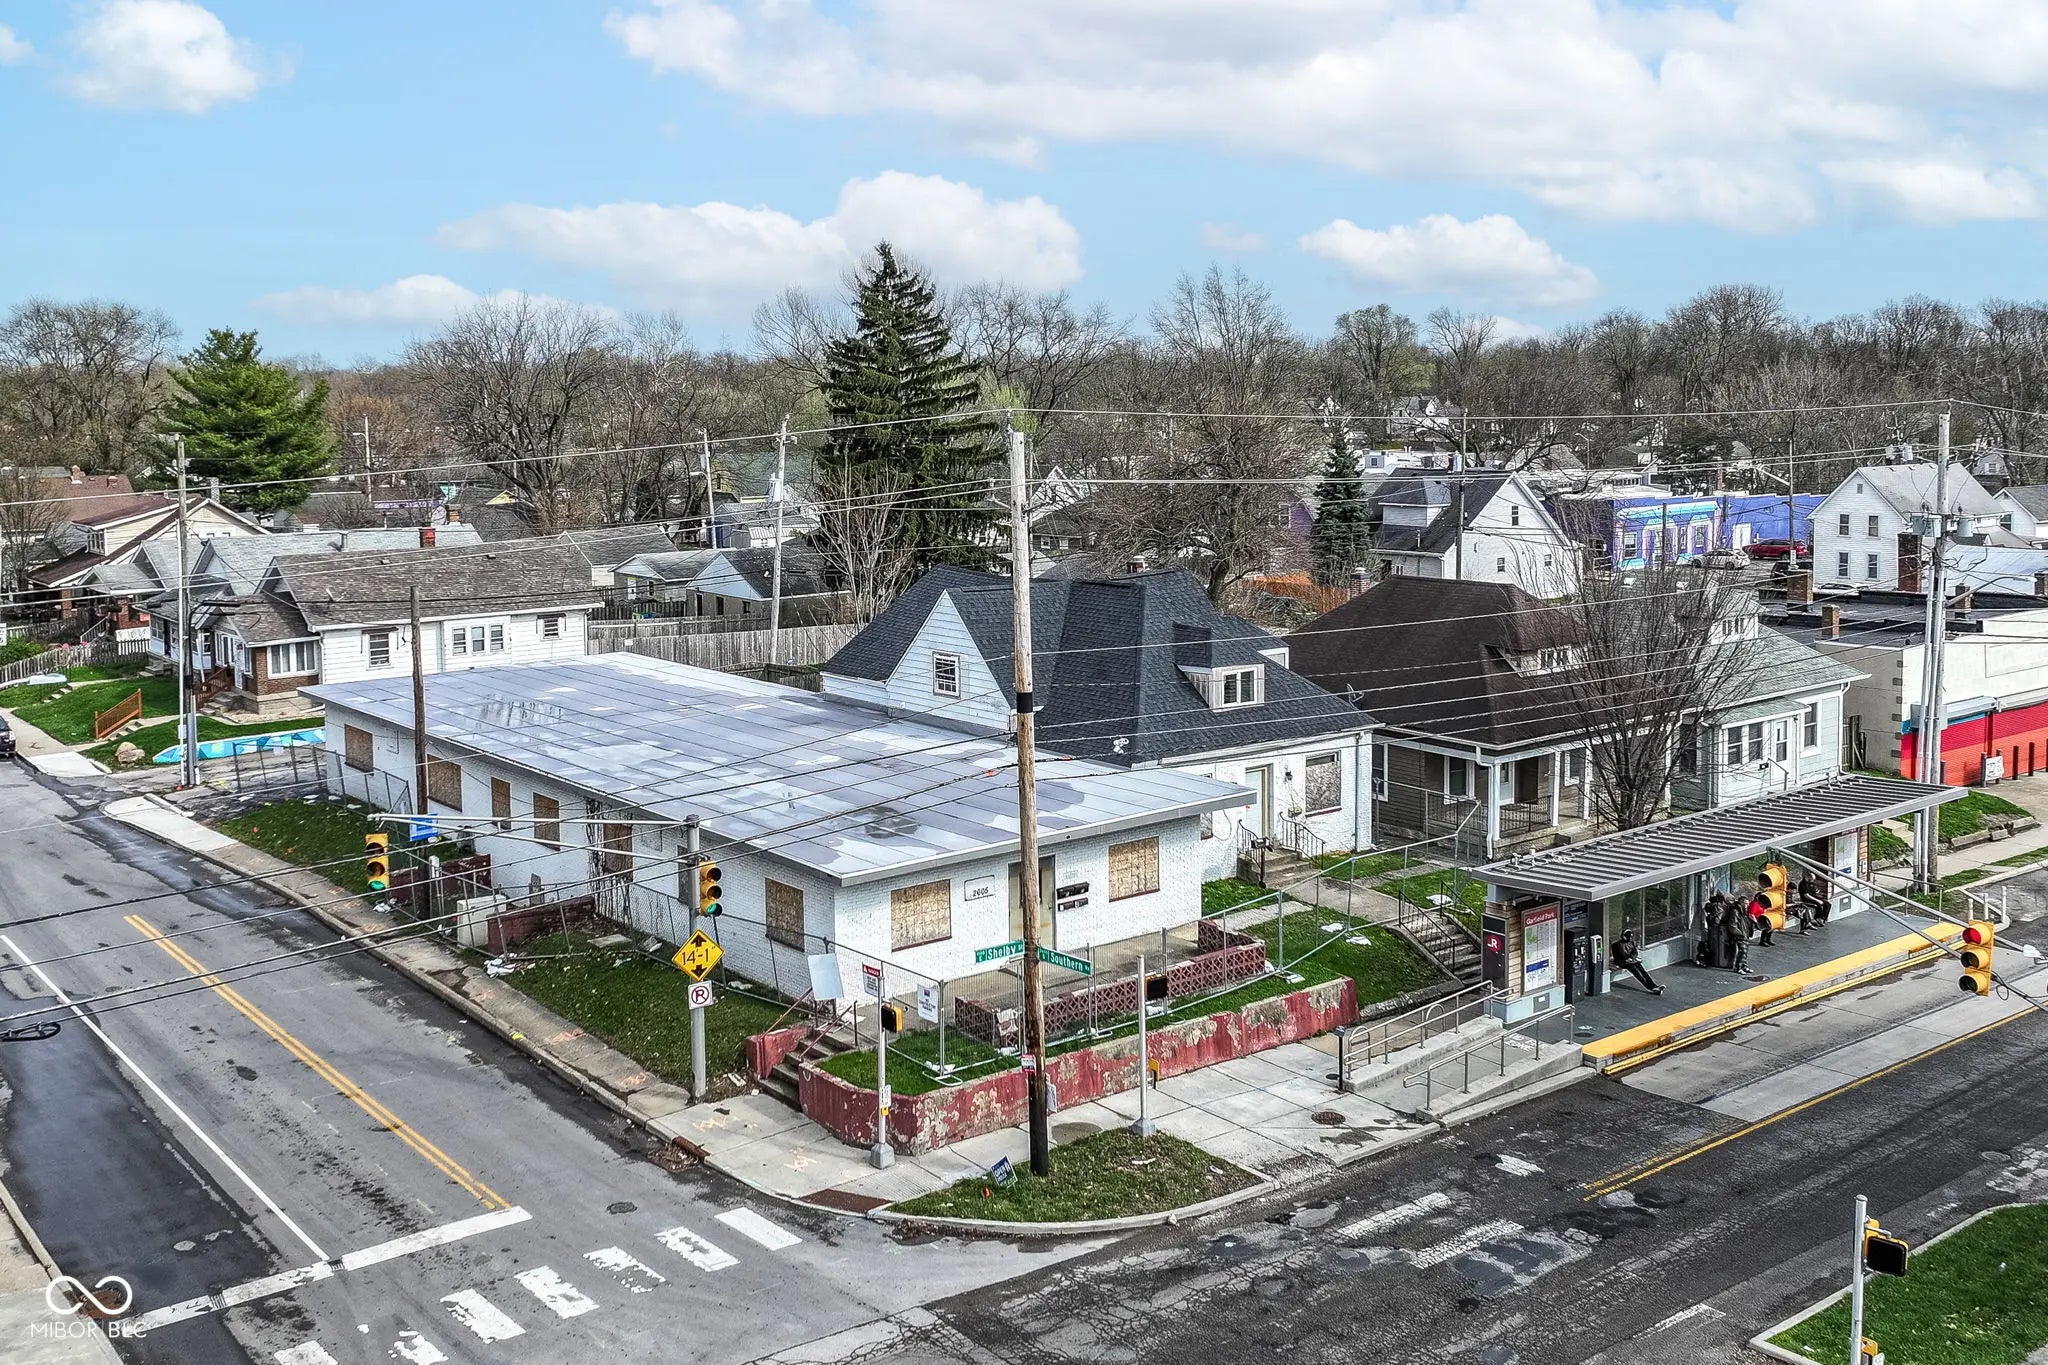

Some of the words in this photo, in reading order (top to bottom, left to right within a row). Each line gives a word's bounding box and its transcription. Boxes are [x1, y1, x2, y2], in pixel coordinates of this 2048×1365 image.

[1526, 914, 1545, 925] Garfield
[1545, 912, 1555, 920] Park
[987, 945, 1016, 960] Shelby
[1050, 952, 1083, 972] Southern
